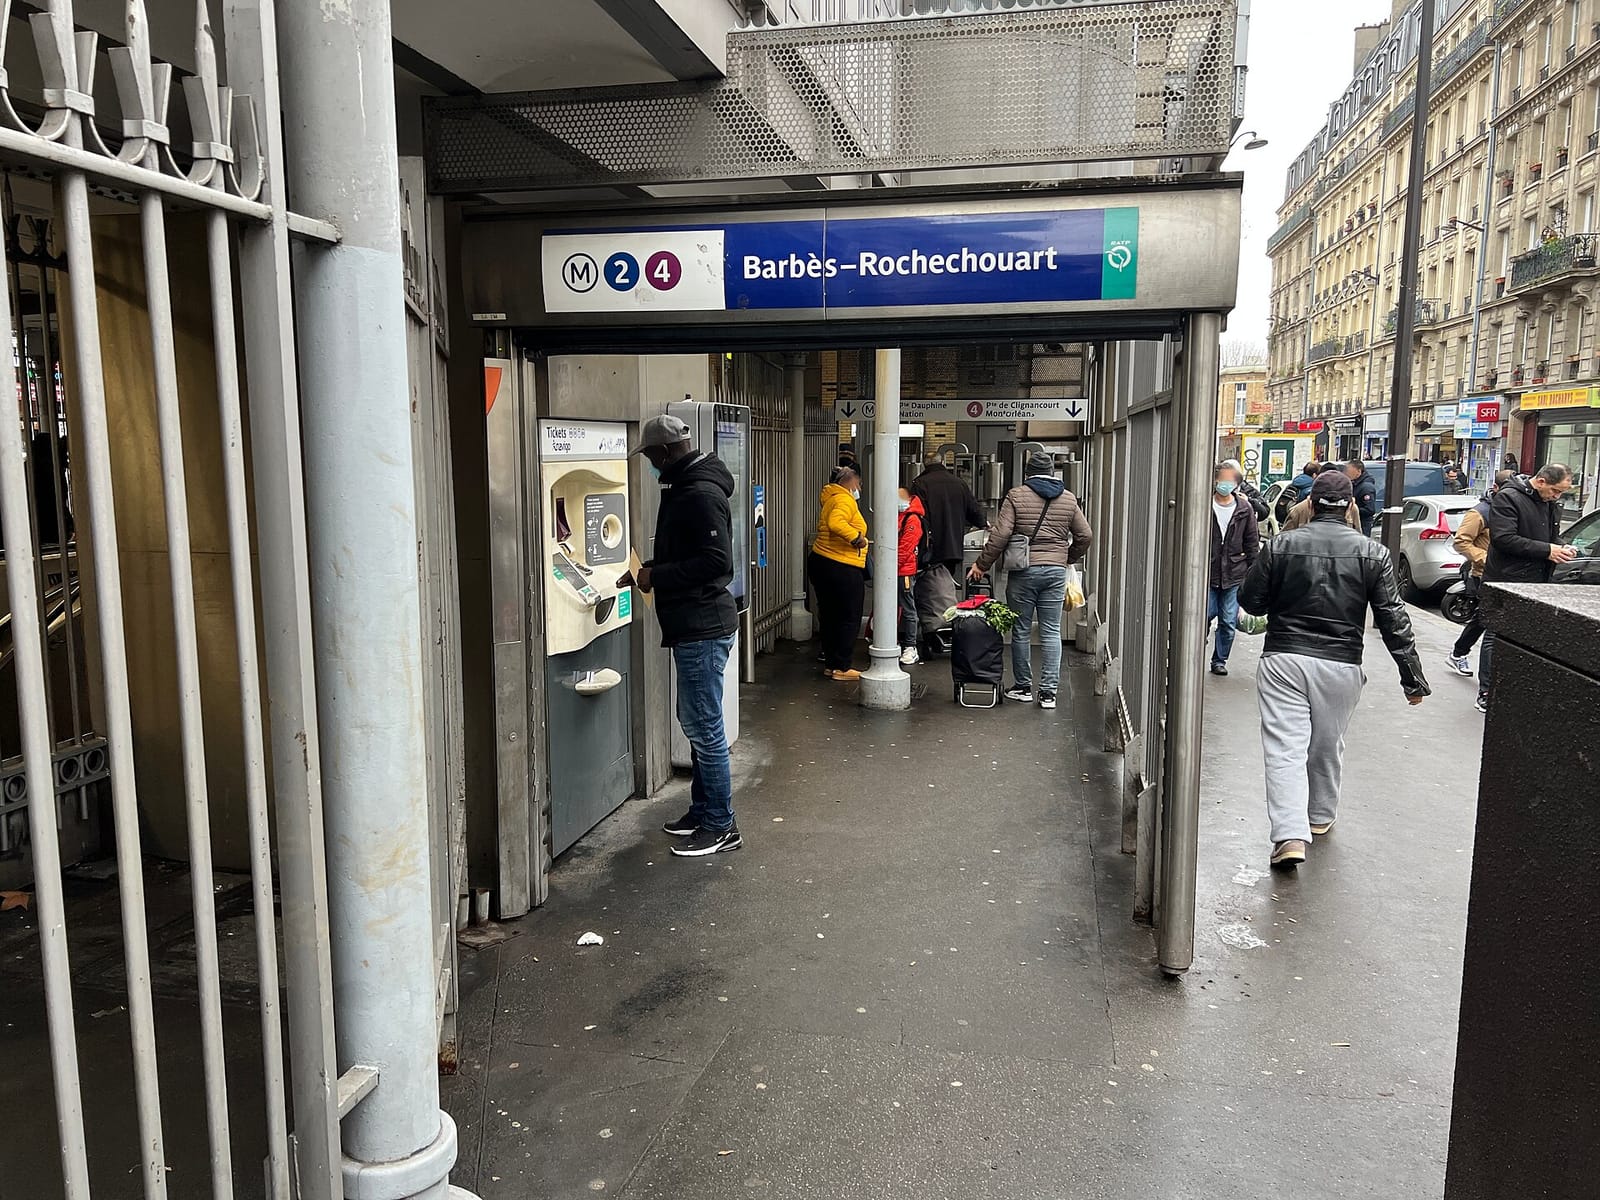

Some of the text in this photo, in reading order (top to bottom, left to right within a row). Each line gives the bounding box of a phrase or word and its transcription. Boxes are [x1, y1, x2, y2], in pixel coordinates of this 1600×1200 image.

[613, 259, 630, 284] 2
[653, 258, 671, 283] 4
[911, 402, 948, 410] Dauphine
[998, 401, 1009, 409] de
[1010, 401, 1060, 411] Clignancourt
[1480, 407, 1497, 418] SFR
[546, 426, 567, 439] Tickets
